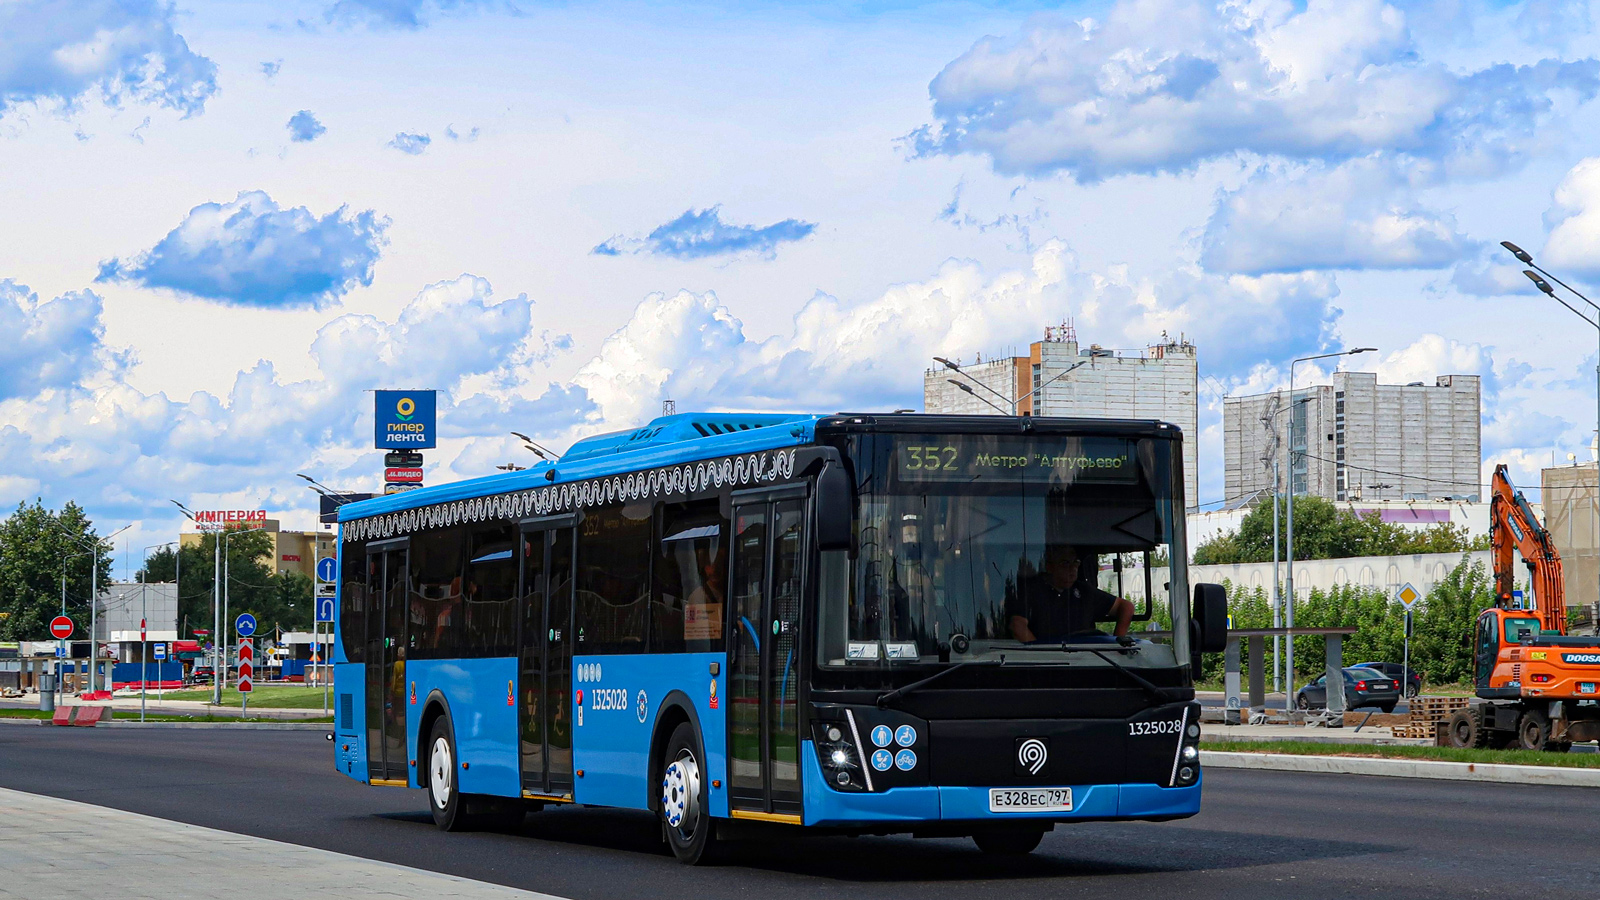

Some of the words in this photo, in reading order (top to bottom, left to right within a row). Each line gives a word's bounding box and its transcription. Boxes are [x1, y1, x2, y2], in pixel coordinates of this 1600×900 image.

[387, 423, 425, 433] гипер
[386, 433, 426, 442] лента
[905, 446, 958, 471] 352
[975, 453, 1028, 468] Метро
[1034, 454, 1127, 469] "Алтуфьево"
[195, 510, 266, 522] ИМПЕРИЯ
[584, 515, 599, 536] 352
[592, 689, 628, 710] 1325028
[1128, 720, 1182, 736] 1325028
